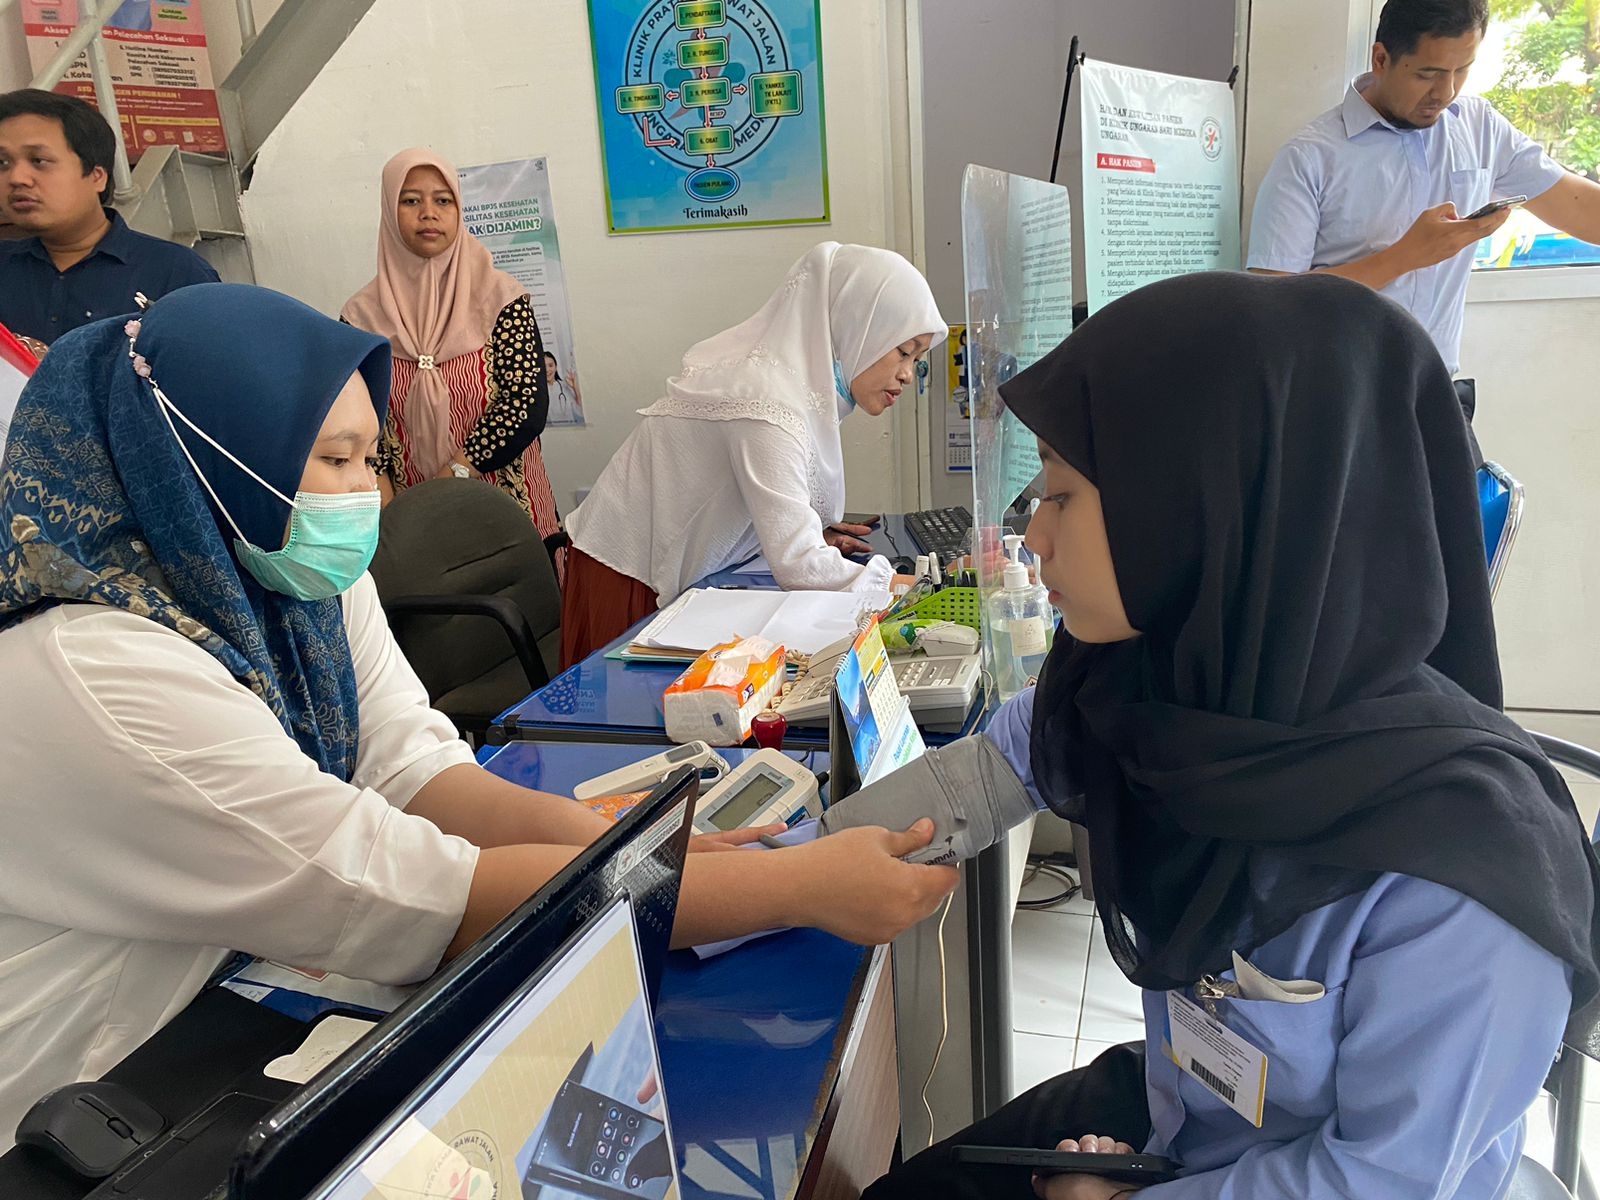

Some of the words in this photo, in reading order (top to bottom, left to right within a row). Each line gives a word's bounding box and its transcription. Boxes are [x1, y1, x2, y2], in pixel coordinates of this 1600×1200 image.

[44, 26, 69, 35] Akses
[633, 30, 651, 78] KLINIK
[647, 0, 676, 29] PRAT
[727, 0, 755, 19] WAT
[753, 18, 777, 65] JALAN
[70, 71, 92, 79] Kota
[1100, 117, 1108, 127] DI
[1108, 157, 1122, 166] HAK
[1122, 159, 1142, 168] PASIEN
[481, 202, 498, 211] BPJS
[499, 198, 538, 209] KESEHATAN
[682, 204, 748, 219] Terimakasih
[463, 213, 492, 222] SILITAS
[495, 207, 539, 218] KESEHATAN
[486, 218, 541, 234] DIJAMIN?
[454, 1136, 479, 1149] RAWAT
[479, 1138, 494, 1163] JALAN
